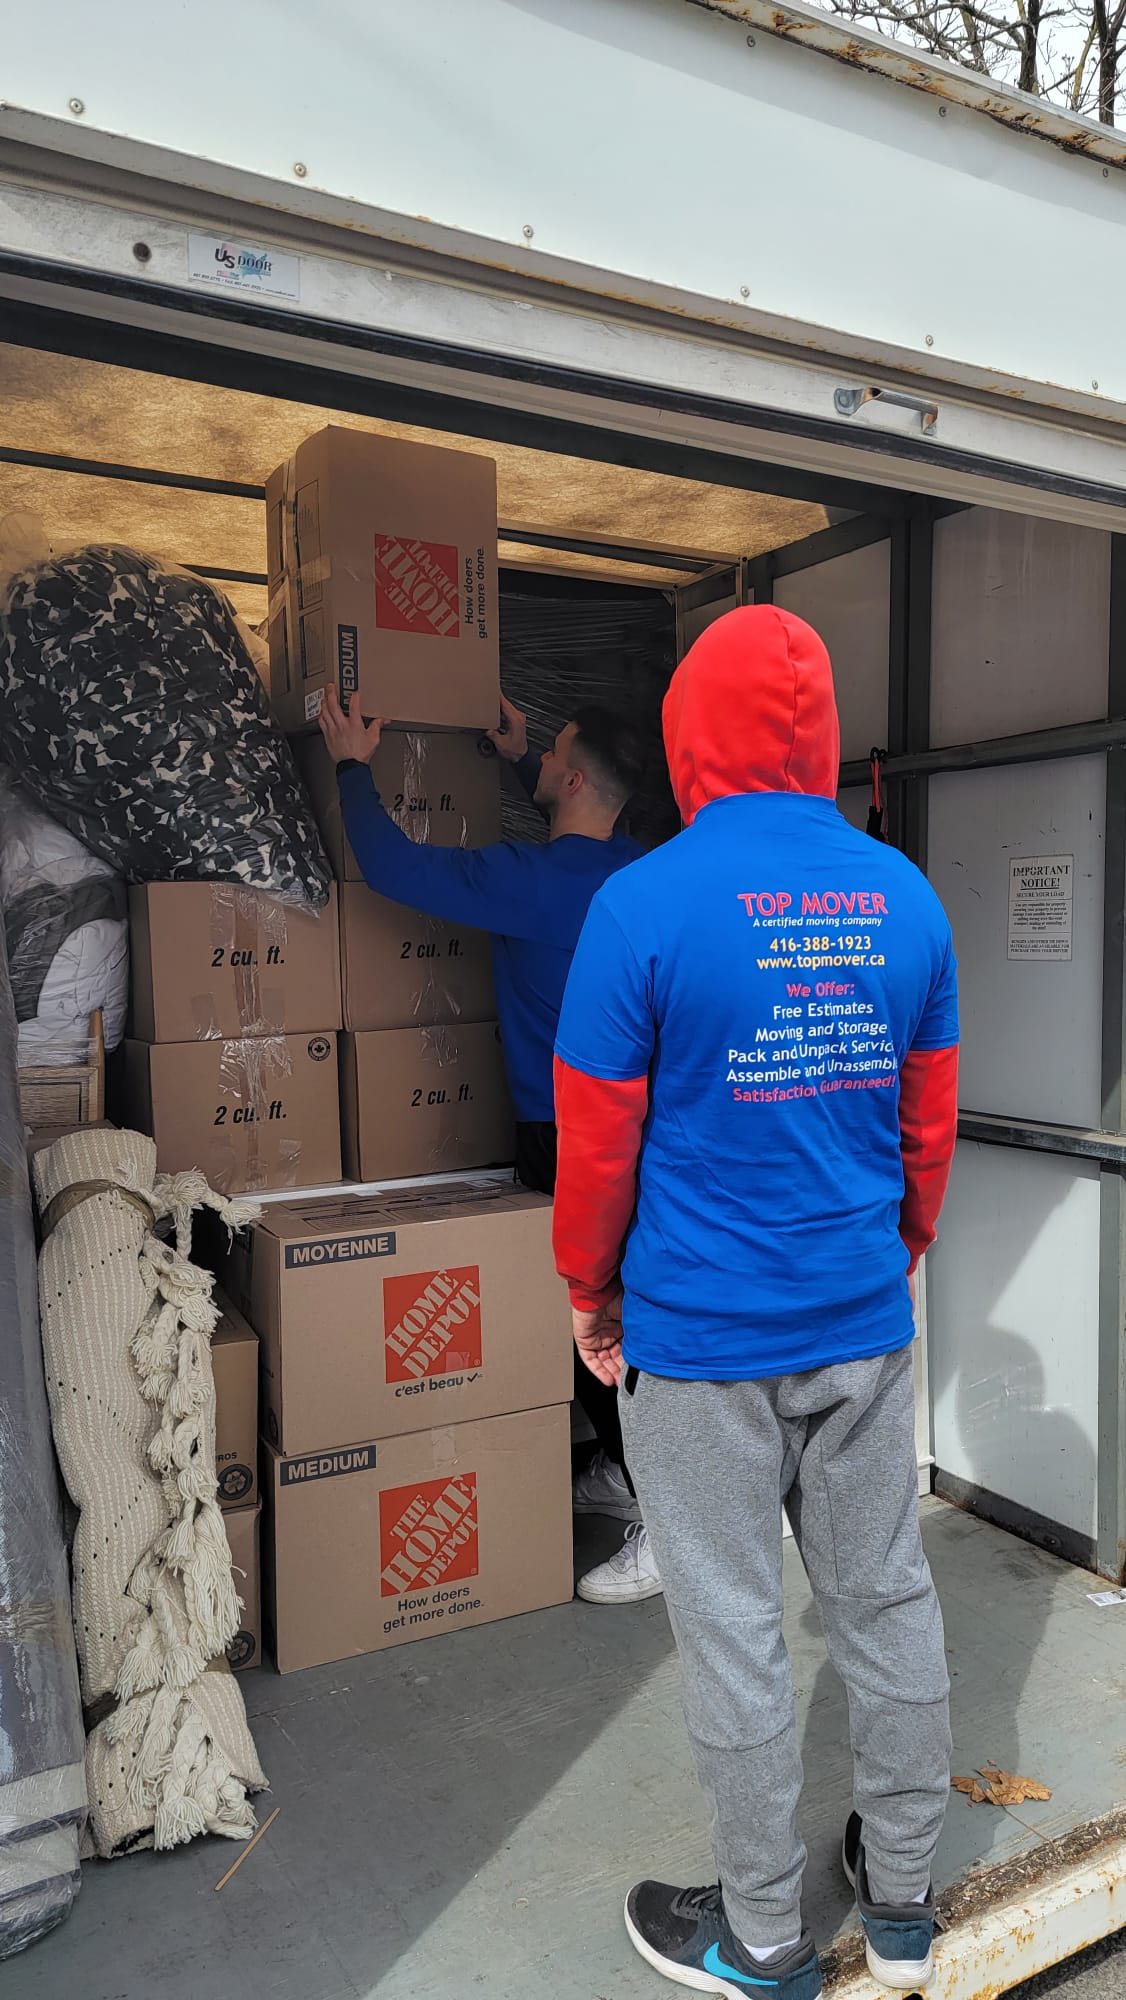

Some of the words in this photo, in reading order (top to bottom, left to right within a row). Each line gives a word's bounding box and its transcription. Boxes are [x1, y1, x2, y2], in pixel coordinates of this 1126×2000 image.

[238, 255, 272, 272] DOOR
[406, 540, 460, 601] DEPOT
[464, 558, 473, 593] doers
[375, 535, 460, 635] HOME
[384, 582, 418, 623] THE
[464, 597, 474, 624] How
[478, 583, 486, 615] more
[477, 619, 487, 638] get
[393, 793, 405, 812] 2
[409, 796, 433, 812] cu.
[440, 793, 456, 811] ft.
[1013, 864, 1071, 877] IMPORTANT
[1020, 877, 1060, 888] NOTICE!
[737, 891, 792, 917] TOP
[801, 891, 889, 915] MOVER
[753, 918, 761, 928] A
[762, 917, 804, 929] certified
[806, 916, 840, 927] moving
[842, 917, 883, 927] company
[211, 948, 225, 967] 2
[230, 950, 258, 967] cu.
[266, 945, 285, 964] ft.
[400, 941, 412, 959] 2
[416, 943, 441, 958] cu.
[448, 938, 464, 957] ft.
[769, 935, 872, 953] 416-388-1923
[756, 954, 886, 971] www.topmover.ca
[785, 983, 811, 998] We
[815, 981, 856, 997] Offer:
[773, 1005, 803, 1020] Free
[808, 1001, 874, 1017] Estimates
[755, 1025, 803, 1042] Moving
[808, 1022, 834, 1037] and
[838, 1021, 888, 1036] Storage
[728, 1048, 767, 1063] Pack
[772, 1044, 798, 1061] and
[799, 1042, 848, 1060] Unpack
[726, 1065, 801, 1082] Assemble
[804, 1061, 825, 1078] and
[411, 1088, 423, 1107] 2
[427, 1089, 451, 1105] cu.
[458, 1083, 473, 1101] ft.
[820, 1074, 896, 1094] Guaranteed!
[214, 1105, 227, 1125] 2
[232, 1107, 260, 1123] cu.
[269, 1100, 287, 1120] ft.
[293, 1236, 389, 1264] MOYENNE
[385, 1269, 460, 1358] HOME
[402, 1279, 480, 1378] DEPOT
[395, 1381, 426, 1397] c'est
[429, 1376, 464, 1391] beau
[288, 1450, 369, 1480] MEDIUM
[389, 1494, 431, 1541] THE
[381, 1474, 478, 1592] HOME
[420, 1512, 478, 1586] DEPOT
[398, 1596, 428, 1612] How
[432, 1586, 470, 1604] doers
[383, 1615, 406, 1633] get
[409, 1608, 444, 1625] more
[448, 1599, 485, 1615] done.
